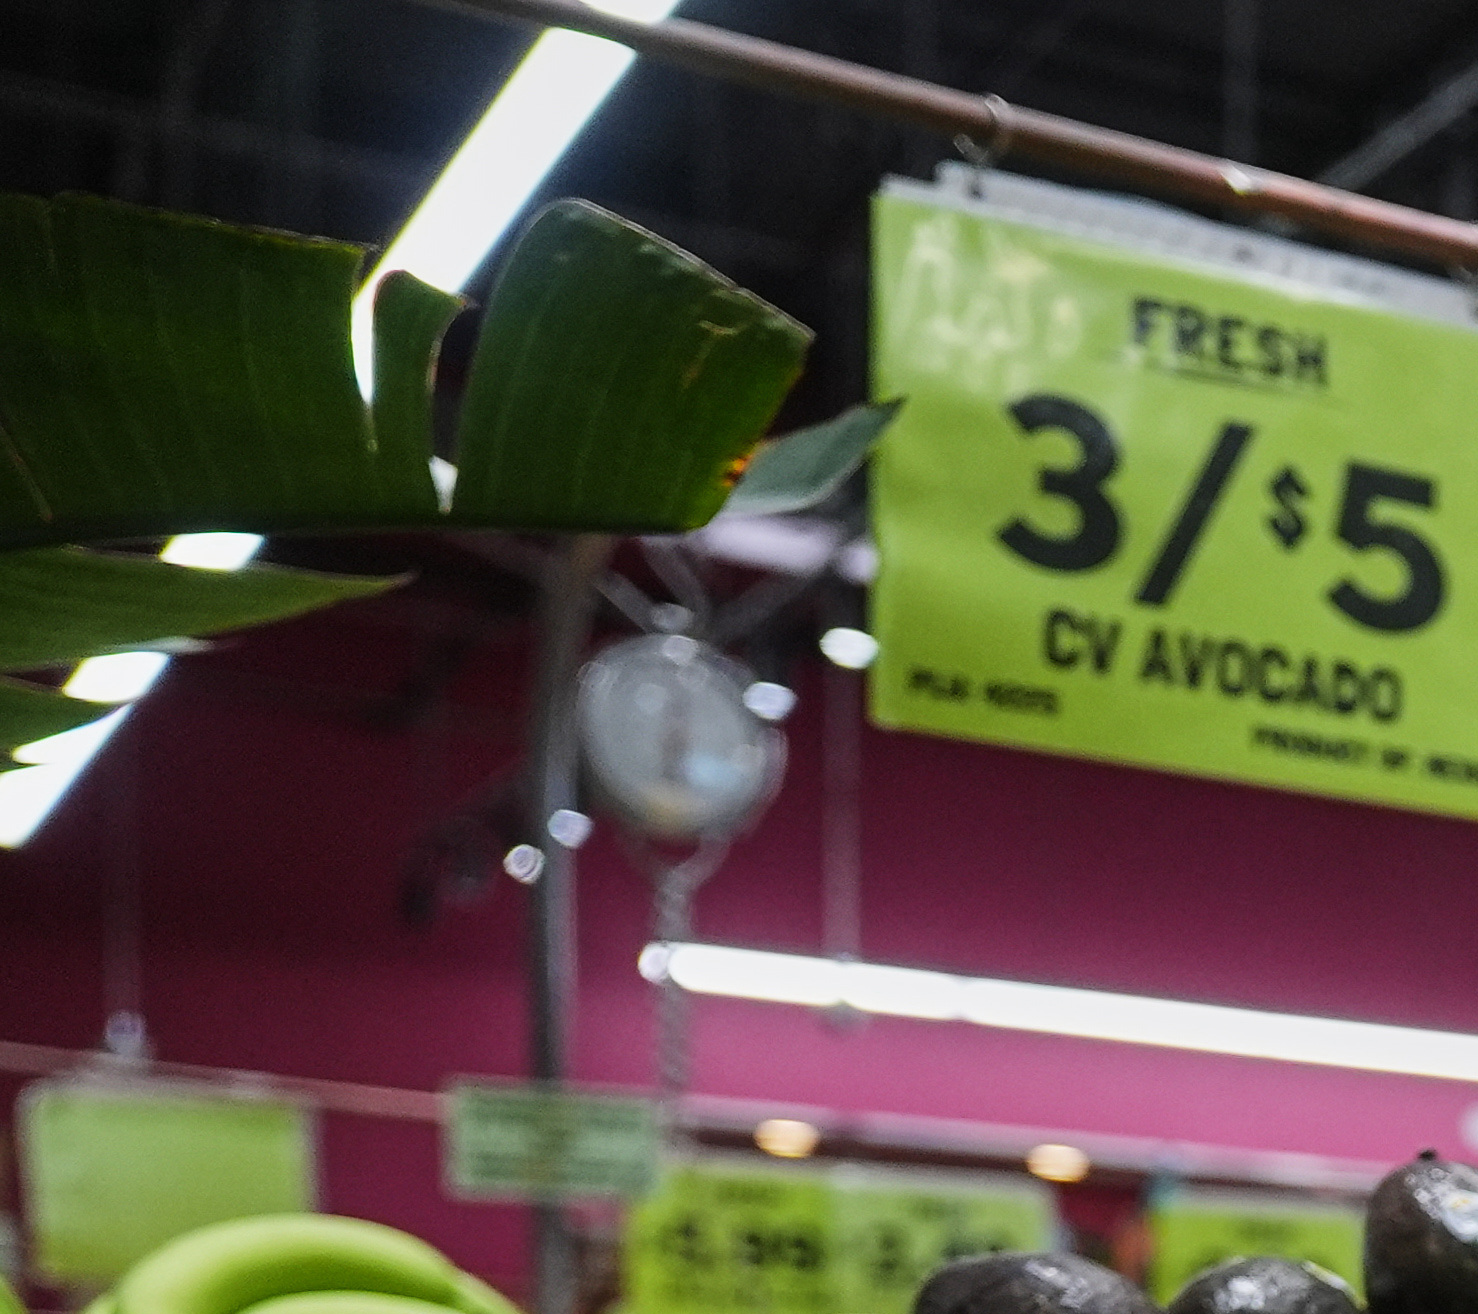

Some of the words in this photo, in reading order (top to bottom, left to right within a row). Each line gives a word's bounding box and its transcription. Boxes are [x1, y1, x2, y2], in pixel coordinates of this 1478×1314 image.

[1131, 296, 1329, 389] FRESH
[1043, 608, 1122, 674] CV
[1138, 627, 1404, 724] AVOCADO
